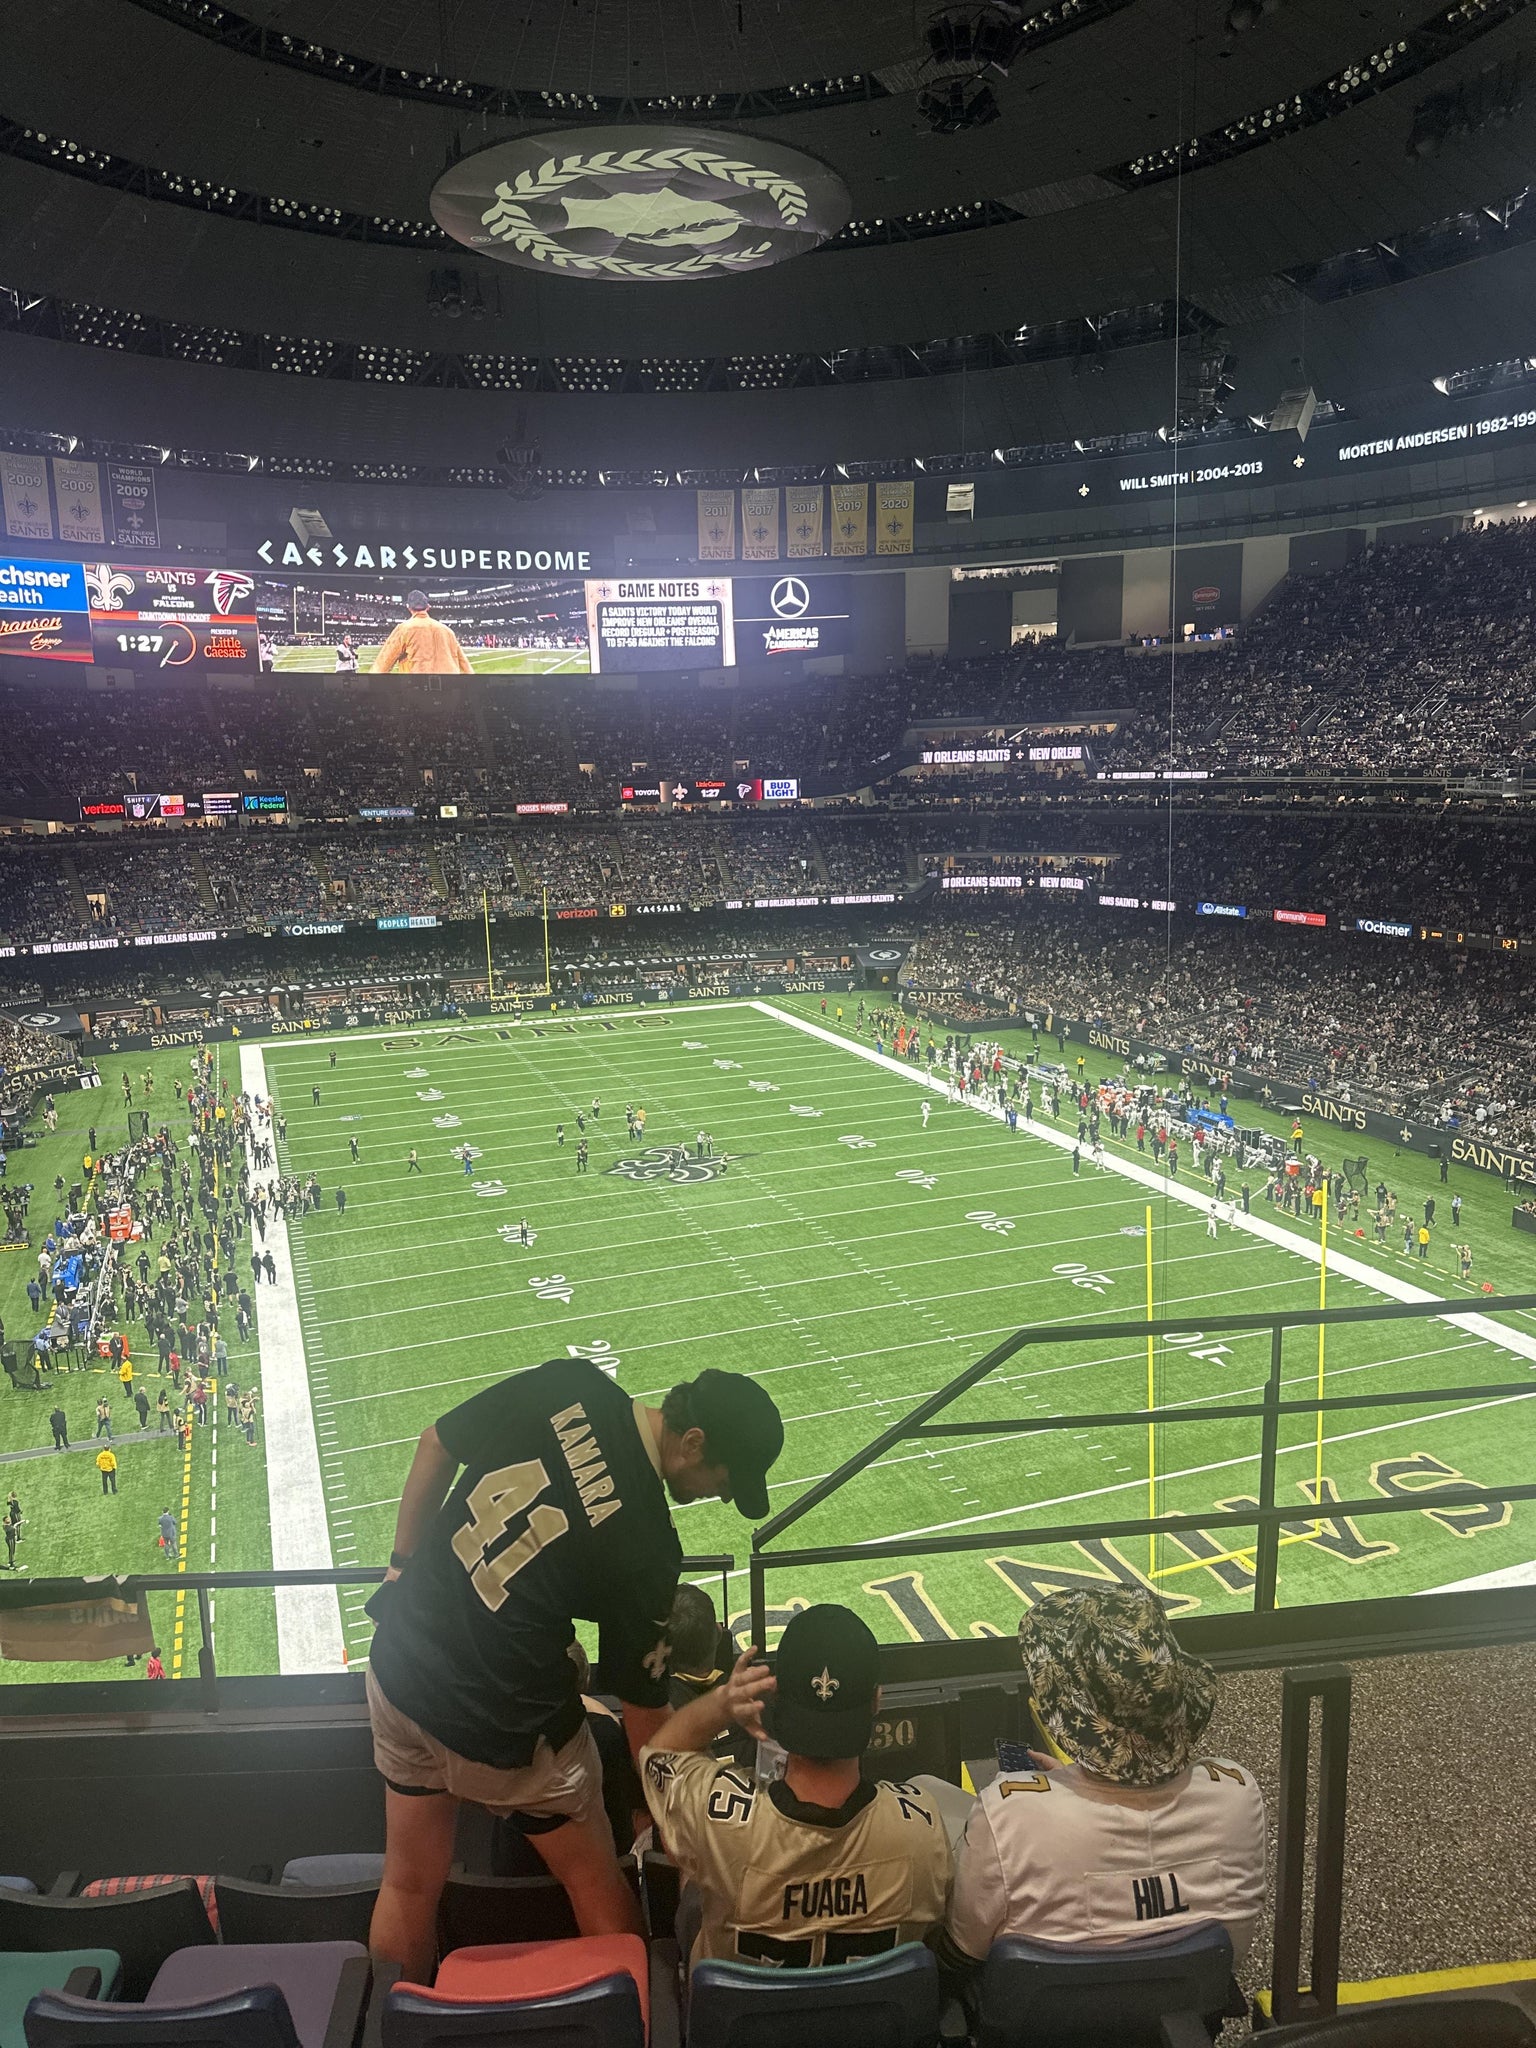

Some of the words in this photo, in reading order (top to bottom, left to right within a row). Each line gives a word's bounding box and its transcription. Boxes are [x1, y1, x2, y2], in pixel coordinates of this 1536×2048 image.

[1339, 438, 1393, 461] MORTEN
[1396, 425, 1467, 450] ANDERSEN
[118, 467, 143, 476] WORLD
[1120, 477, 1148, 490] WILL
[1150, 472, 1188, 488] SMITH
[1196, 461, 1263, 482] 2004-2013
[8, 473, 42, 487] 2009
[111, 473, 151, 483] CHAMPIONS
[61, 479, 94, 493] 2009
[116, 485, 149, 497] 2009
[791, 502, 817, 513] 2018
[837, 501, 862, 512] 2019
[880, 499, 909, 510] 2020
[705, 506, 728, 517] 2011
[748, 505, 773, 517] 2017
[10, 525, 50, 537] SAINTS
[62, 529, 101, 541] SAINTS
[118, 534, 156, 546] SAINTS
[701, 549, 733, 559] SAINTS
[789, 546, 820, 557] SAINTS
[833, 545, 865, 555] SAINTS
[878, 543, 911, 553] SAINTS
[257, 539, 419, 570] CAESARS
[422, 547, 592, 571] SUPERDOME
[744, 550, 777, 559] SAINTS
[145, 571, 196, 585] SAINTS
[167, 584, 177, 593] VS
[618, 583, 655, 598] GAME
[659, 582, 699, 597] NOTES
[153, 599, 195, 609] FALCONS
[138, 611, 176, 621] COUNTDOWN
[177, 613, 186, 622] TO
[186, 613, 211, 622] KICKOFF
[602, 607, 608, 616] A
[608, 606, 635, 616] SAINTS
[636, 606, 667, 616] VICTORY
[668, 606, 692, 616] TODAY
[692, 605, 717, 616] WOULD
[602, 617, 636, 627] IMPROVE
[637, 617, 653, 627] NEW
[687, 616, 718, 626] OVERALL
[602, 627, 630, 637] RECORD
[762, 625, 819, 640] AMERICAS
[117, 634, 164, 653] 1:27
[210, 636, 241, 648] Little
[606, 638, 616, 647] TO
[638, 637, 669, 647] AGAINST
[669, 637, 684, 647] THE
[685, 636, 716, 646] FALCONS
[203, 645, 246, 659] Caesars
[934, 751, 975, 763] ORLEANS
[976, 749, 1011, 762] SAINTS
[1029, 748, 1050, 761] NEW
[1250, 769, 1275, 777] SAINTS
[1304, 769, 1331, 777] SAINTS
[1362, 769, 1389, 777] SAINTS
[1422, 769, 1452, 777] SAINTS
[770, 781, 790, 790] BUD
[259, 795, 285, 803] Keesler
[701, 789, 720, 797] 1:27
[766, 789, 795, 797] LIGHT
[83, 803, 124, 815] verizon
[359, 808, 389, 817] VENTURE
[389, 807, 415, 816] GLOBAL
[516, 804, 541, 813] ROUSES
[541, 803, 568, 812] MARKETS
[950, 877, 988, 888] ORLEANS
[989, 877, 1022, 888] SAINTS
[1040, 877, 1059, 888] NEW
[754, 900, 769, 908] NEW
[769, 898, 796, 907] ORLEANS
[796, 898, 819, 906] SAINTS
[831, 896, 844, 905] NEW
[845, 895, 872, 904] ORLEANS
[872, 894, 894, 903] SAINTS
[1115, 897, 1139, 908] SAINTS
[1152, 899, 1167, 911] NEW
[508, 910, 535, 918] SAINTS
[556, 908, 598, 920] verizon
[611, 905, 625, 916] 25
[636, 904, 682, 914] CAESARS
[448, 913, 476, 921] SAINTS
[1276, 910, 1307, 923] Community
[378, 918, 408, 929] PEOPLES
[409, 917, 436, 928] HEALTH
[1364, 920, 1410, 936] Ochsner
[246, 925, 277, 934] SAINTS
[291, 924, 344, 936] Ochsner
[1421, 930, 1427, 940] 3
[32, 944, 51, 955] NEW
[52, 941, 88, 953] ORLEANS
[89, 938, 118, 950] SAINTS
[134, 935, 153, 946] NEW
[153, 933, 188, 945] ORLEANS
[188, 931, 216, 943] SAINTS
[1457, 933, 1463, 943] 0
[1502, 940, 1517, 949] 1:27
[650, 951, 759, 965] SUPERDOME
[320, 973, 444, 989] SUPERDOME
[785, 981, 825, 993] SAINTS
[688, 985, 730, 998] SAINTS
[592, 993, 634, 1005] SAINTS
[490, 1000, 534, 1013] SAINTS
[271, 1018, 320, 1034] SAINS
[151, 1029, 203, 1047] SAINTS
[381, 1015, 674, 1050] SAINTS
[1089, 1029, 1130, 1055] SAINTS
[1182, 1057, 1233, 1082] SAINTS
[11, 1064, 79, 1092] SAINTS
[1302, 1094, 1367, 1130] SAINTS
[432, 1115, 462, 1128] 30
[837, 1135, 877, 1149] 50
[1451, 1138, 1536, 1180] SAINTS
[895, 1169, 939, 1188] 40
[471, 1180, 508, 1197] 50
[965, 1210, 1016, 1233] 30
[497, 1223, 538, 1244] 40
[1052, 1263, 1116, 1289] 20
[528, 1274, 575, 1301] 30
[1163, 1332, 1235, 1360] 10
[566, 1340, 621, 1374] 20
[550, 1402, 623, 1528] KAMARA
[451, 1458, 569, 1613] 41
[867, 1719, 915, 1750] 30
[707, 1769, 757, 1824] 75
[782, 1873, 869, 1921] FUAGA
[1132, 1872, 1190, 1922] HILL
